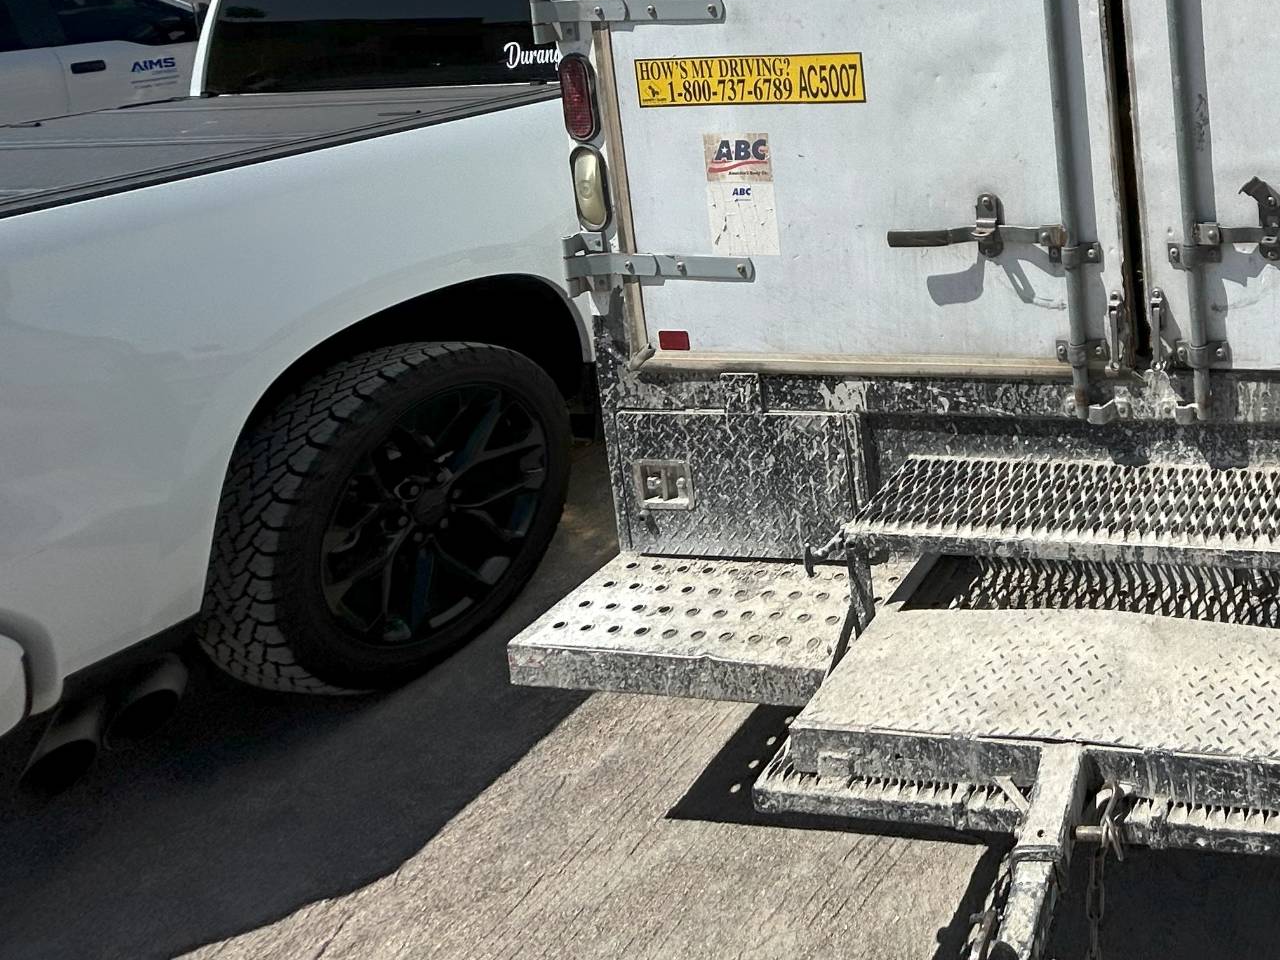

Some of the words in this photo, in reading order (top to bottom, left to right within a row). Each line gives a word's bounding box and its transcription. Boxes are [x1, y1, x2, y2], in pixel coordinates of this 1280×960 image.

[131, 57, 176, 73] AIMS
[503, 41, 562, 71] Durang
[639, 61, 688, 81] HOW'S
[691, 60, 714, 79] MY
[718, 57, 791, 78] DRIVING?
[799, 63, 858, 99] AC5007
[668, 78, 793, 103] 1-800-737-6789
[714, 139, 767, 160] ABC
[732, 187, 752, 196] ABC
